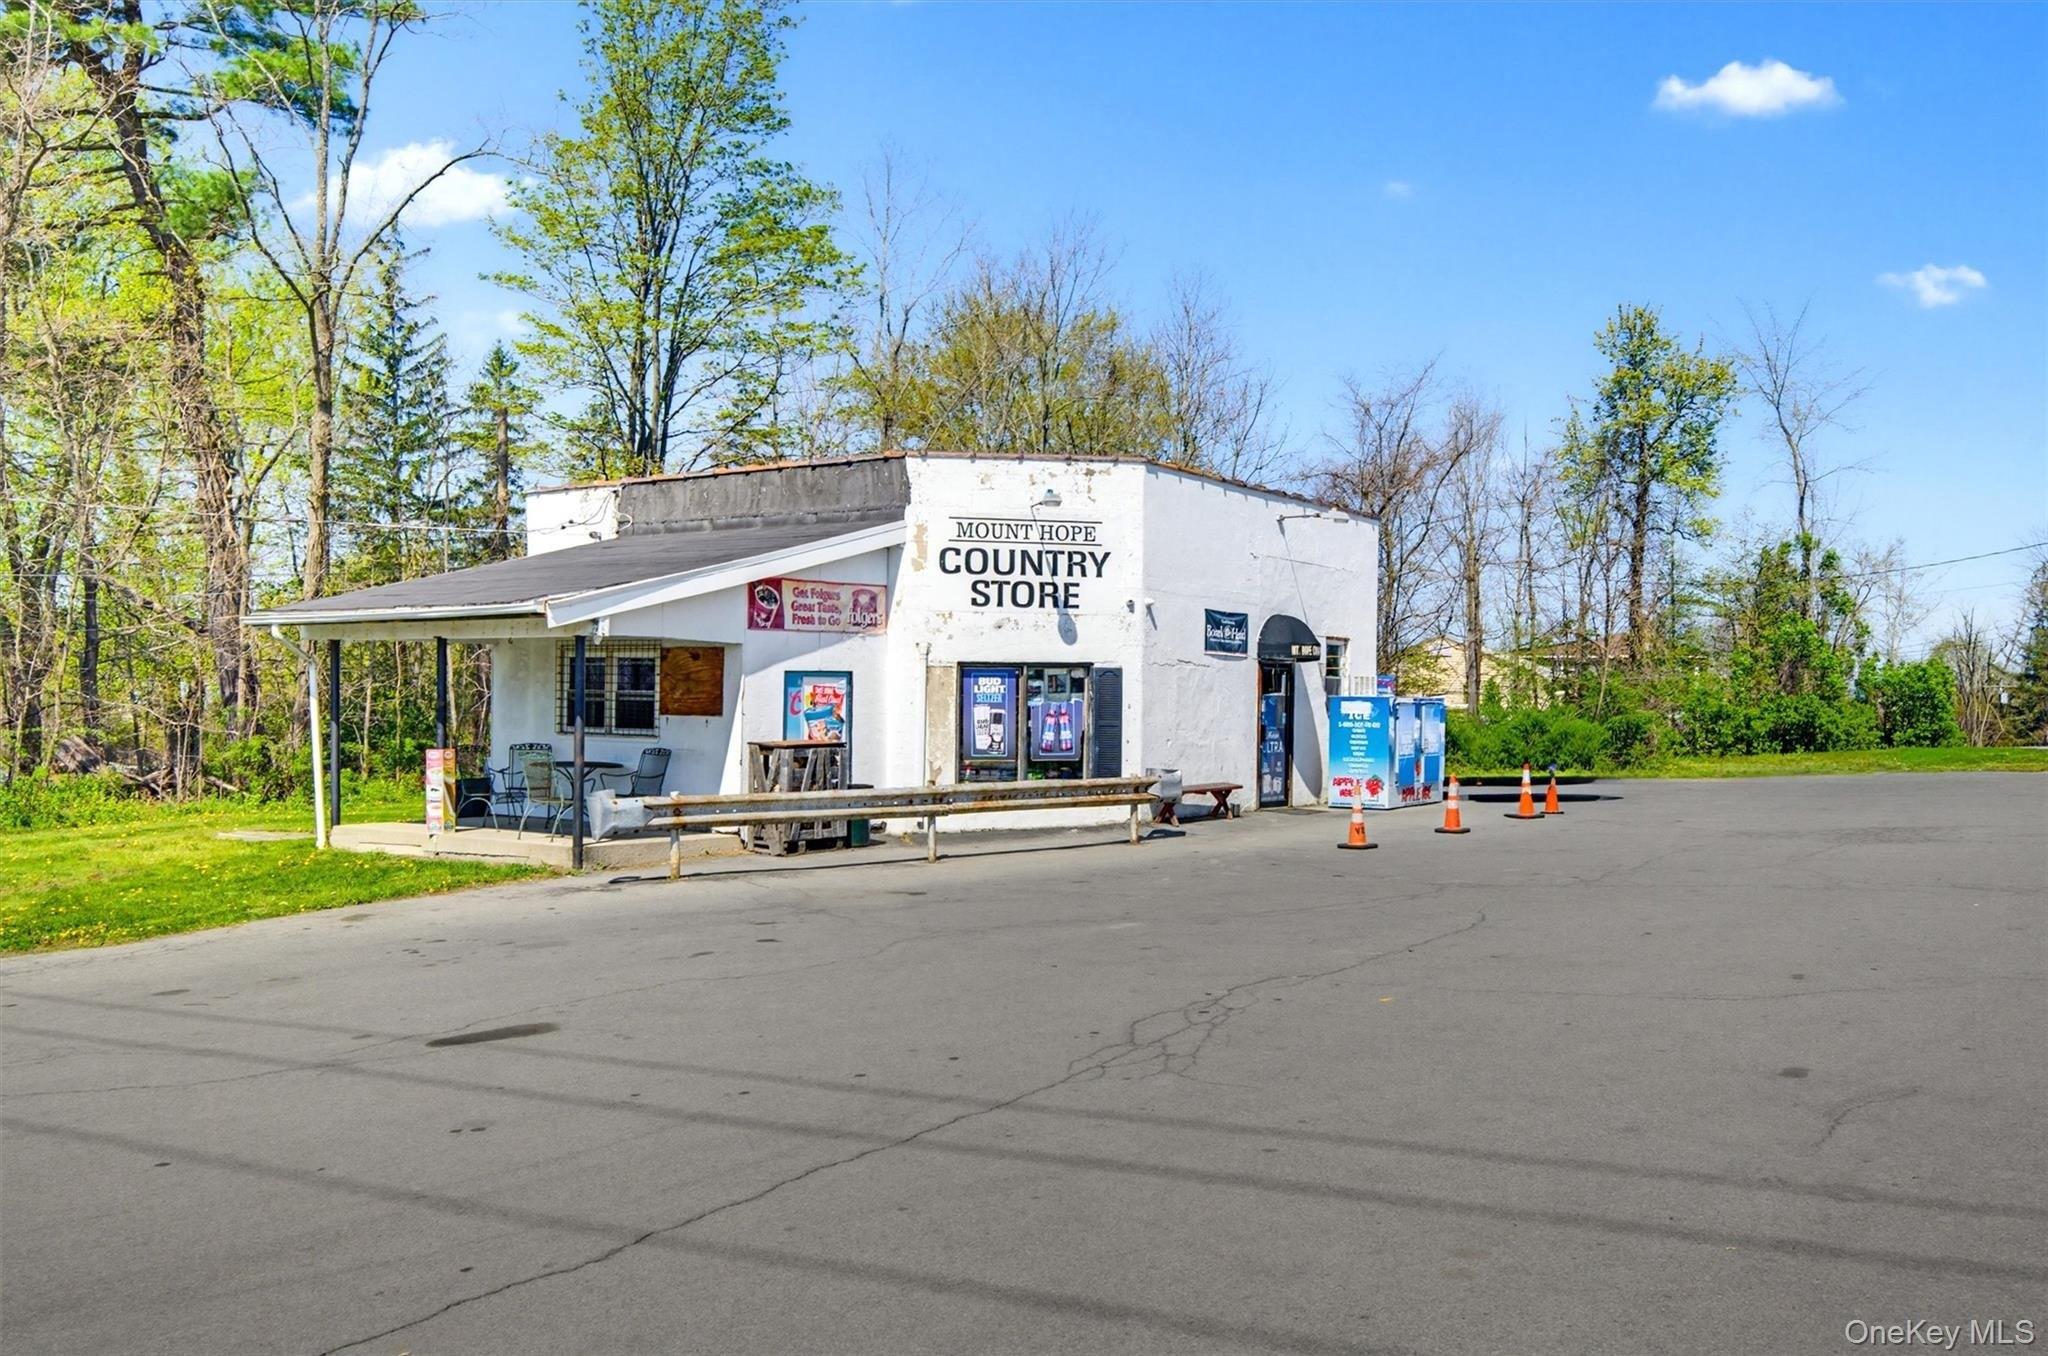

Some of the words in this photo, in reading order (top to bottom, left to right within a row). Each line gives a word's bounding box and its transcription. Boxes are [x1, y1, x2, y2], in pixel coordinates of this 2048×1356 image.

[956, 521, 1034, 540] MOUNT
[1039, 523, 1096, 542] HOPE
[939, 547, 1111, 578] COUNTRY
[792, 586, 808, 599] Get
[970, 579, 1080, 609] STORE
[792, 613, 815, 625] Fresh
[818, 615, 826, 625] to
[828, 615, 841, 626] Go
[978, 677, 1002, 686] BUD
[974, 685, 1007, 694] LIGHT
